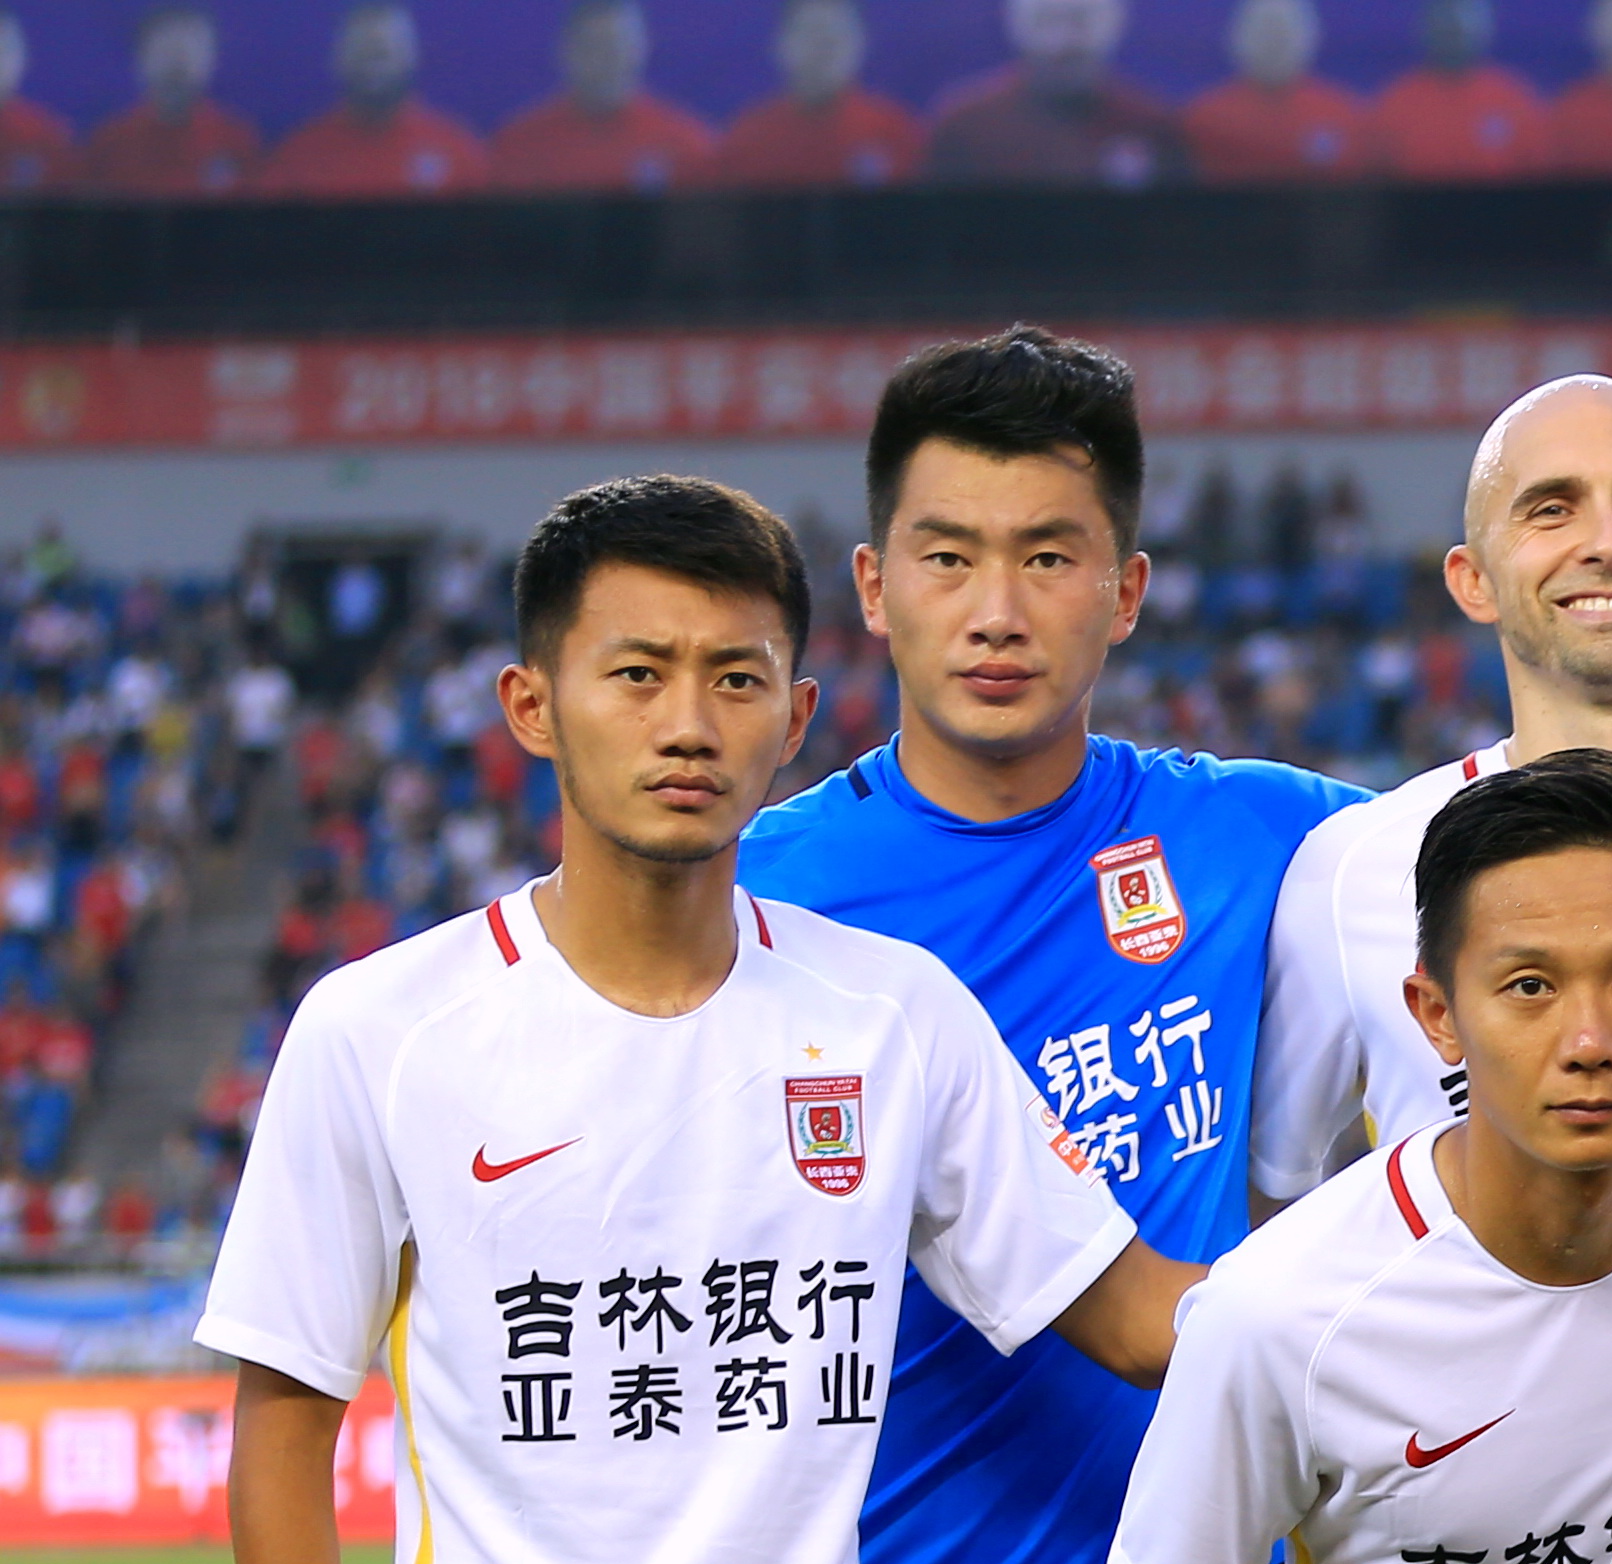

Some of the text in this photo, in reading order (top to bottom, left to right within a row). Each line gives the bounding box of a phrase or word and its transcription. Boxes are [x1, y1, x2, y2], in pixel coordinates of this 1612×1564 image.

[495, 1257, 875, 1362] 吉林银行
[501, 1352, 878, 1443] 亚泰药业
